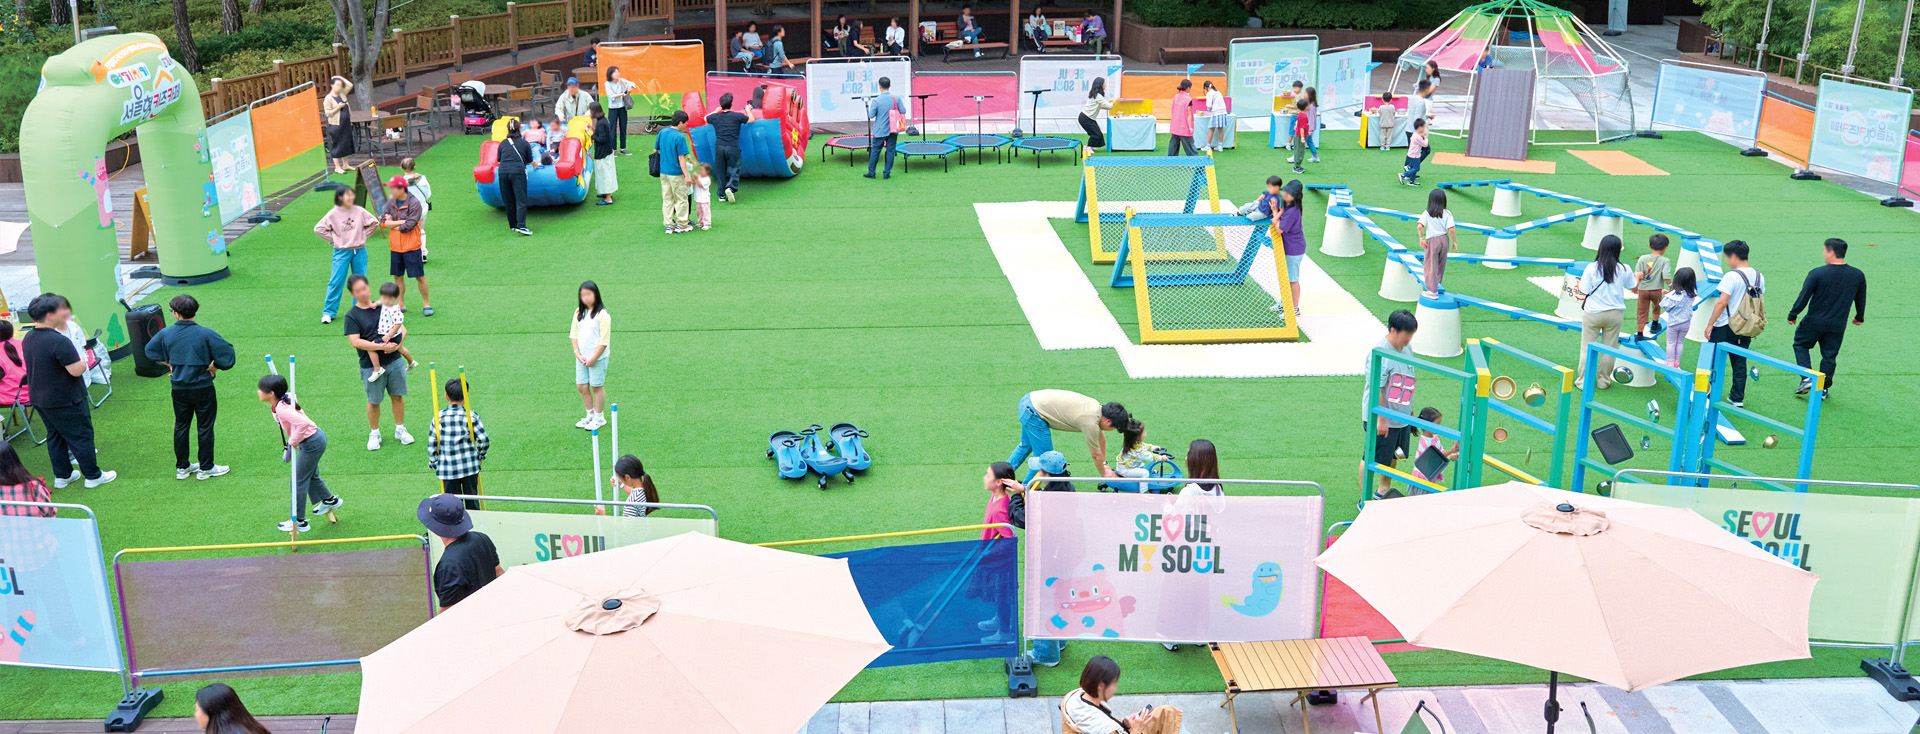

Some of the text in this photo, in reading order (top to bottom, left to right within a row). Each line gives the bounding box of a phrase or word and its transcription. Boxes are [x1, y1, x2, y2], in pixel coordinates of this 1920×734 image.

[1134, 513, 1212, 543] SEOUL
[1721, 509, 1802, 541] SEOUL
[1161, 544, 1225, 574] SOUL
